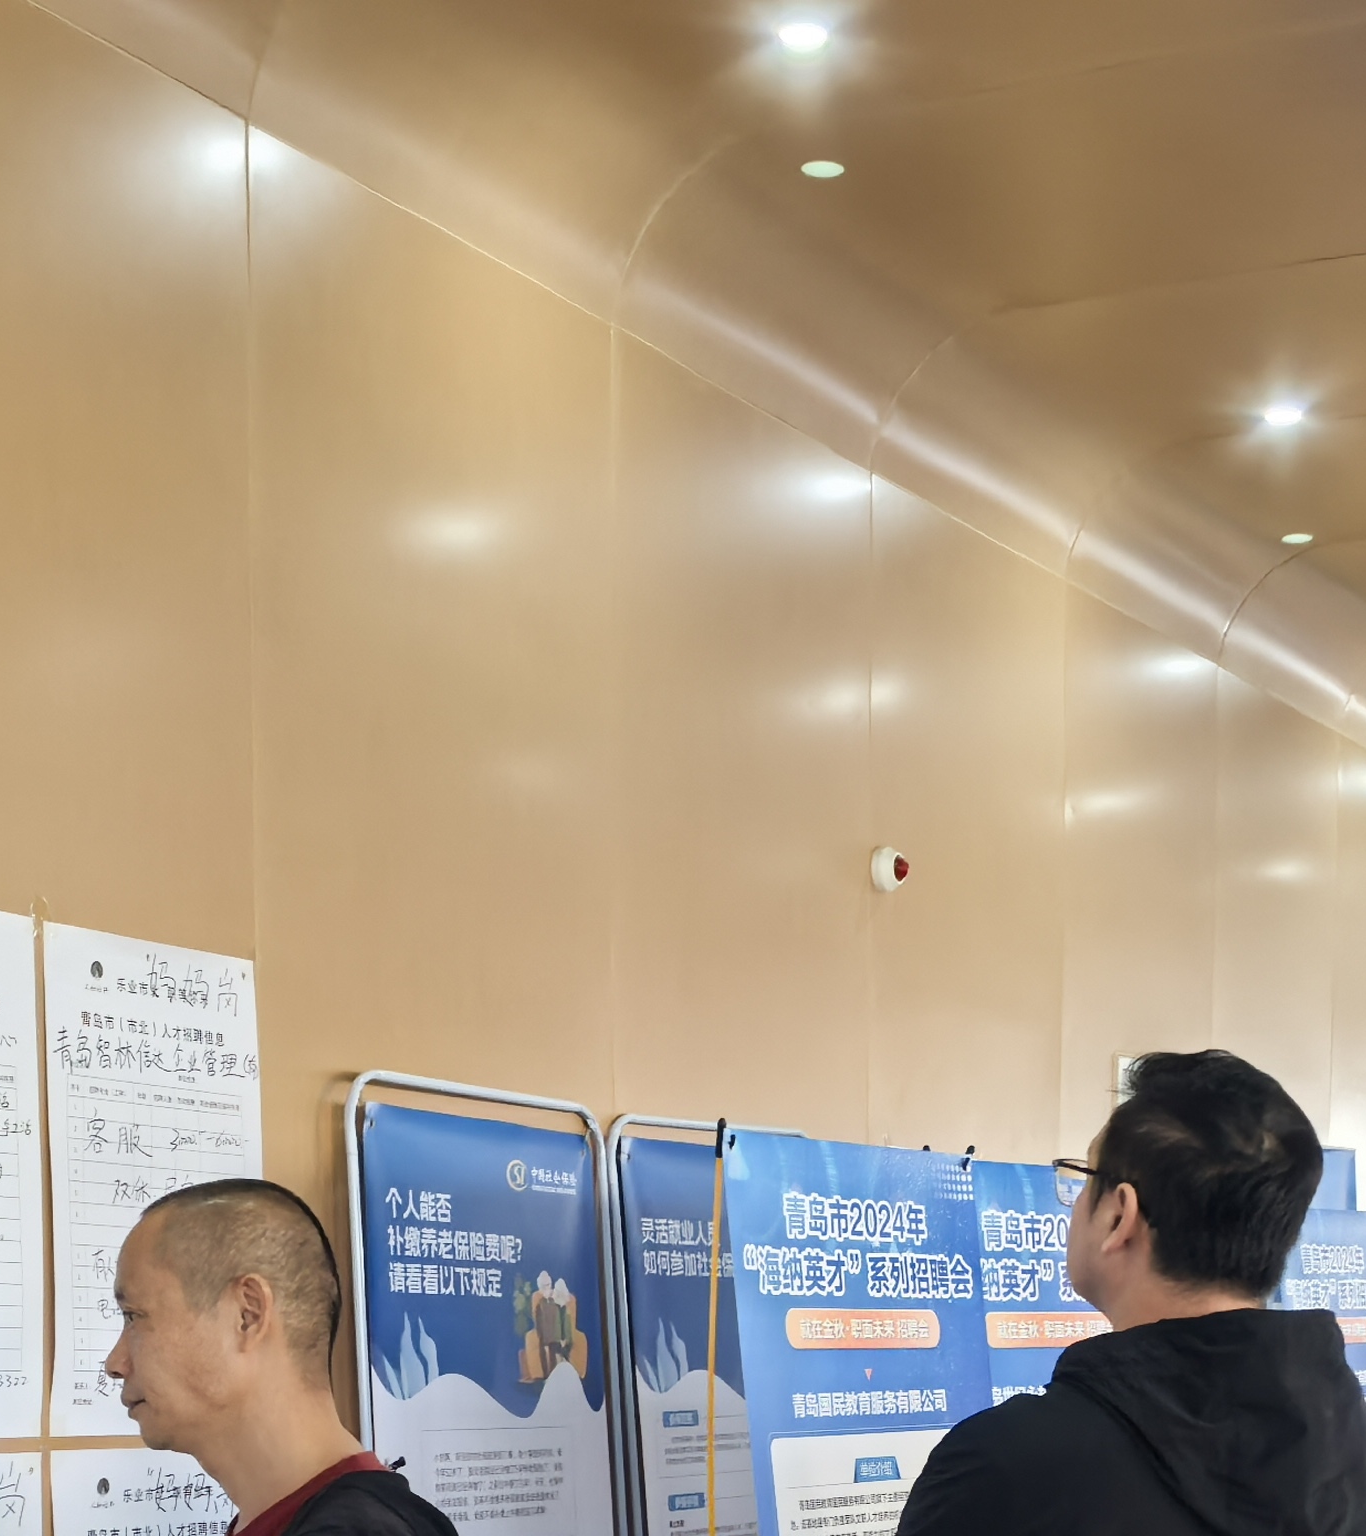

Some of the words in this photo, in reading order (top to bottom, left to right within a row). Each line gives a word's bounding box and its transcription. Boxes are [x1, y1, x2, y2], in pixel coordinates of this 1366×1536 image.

[84, 1107, 153, 1158] 客服
[385, 1187, 452, 1223] 个人能否
[783, 1192, 928, 1245] 青岛市2024年
[389, 1261, 503, 1298] 请看看以下规定
